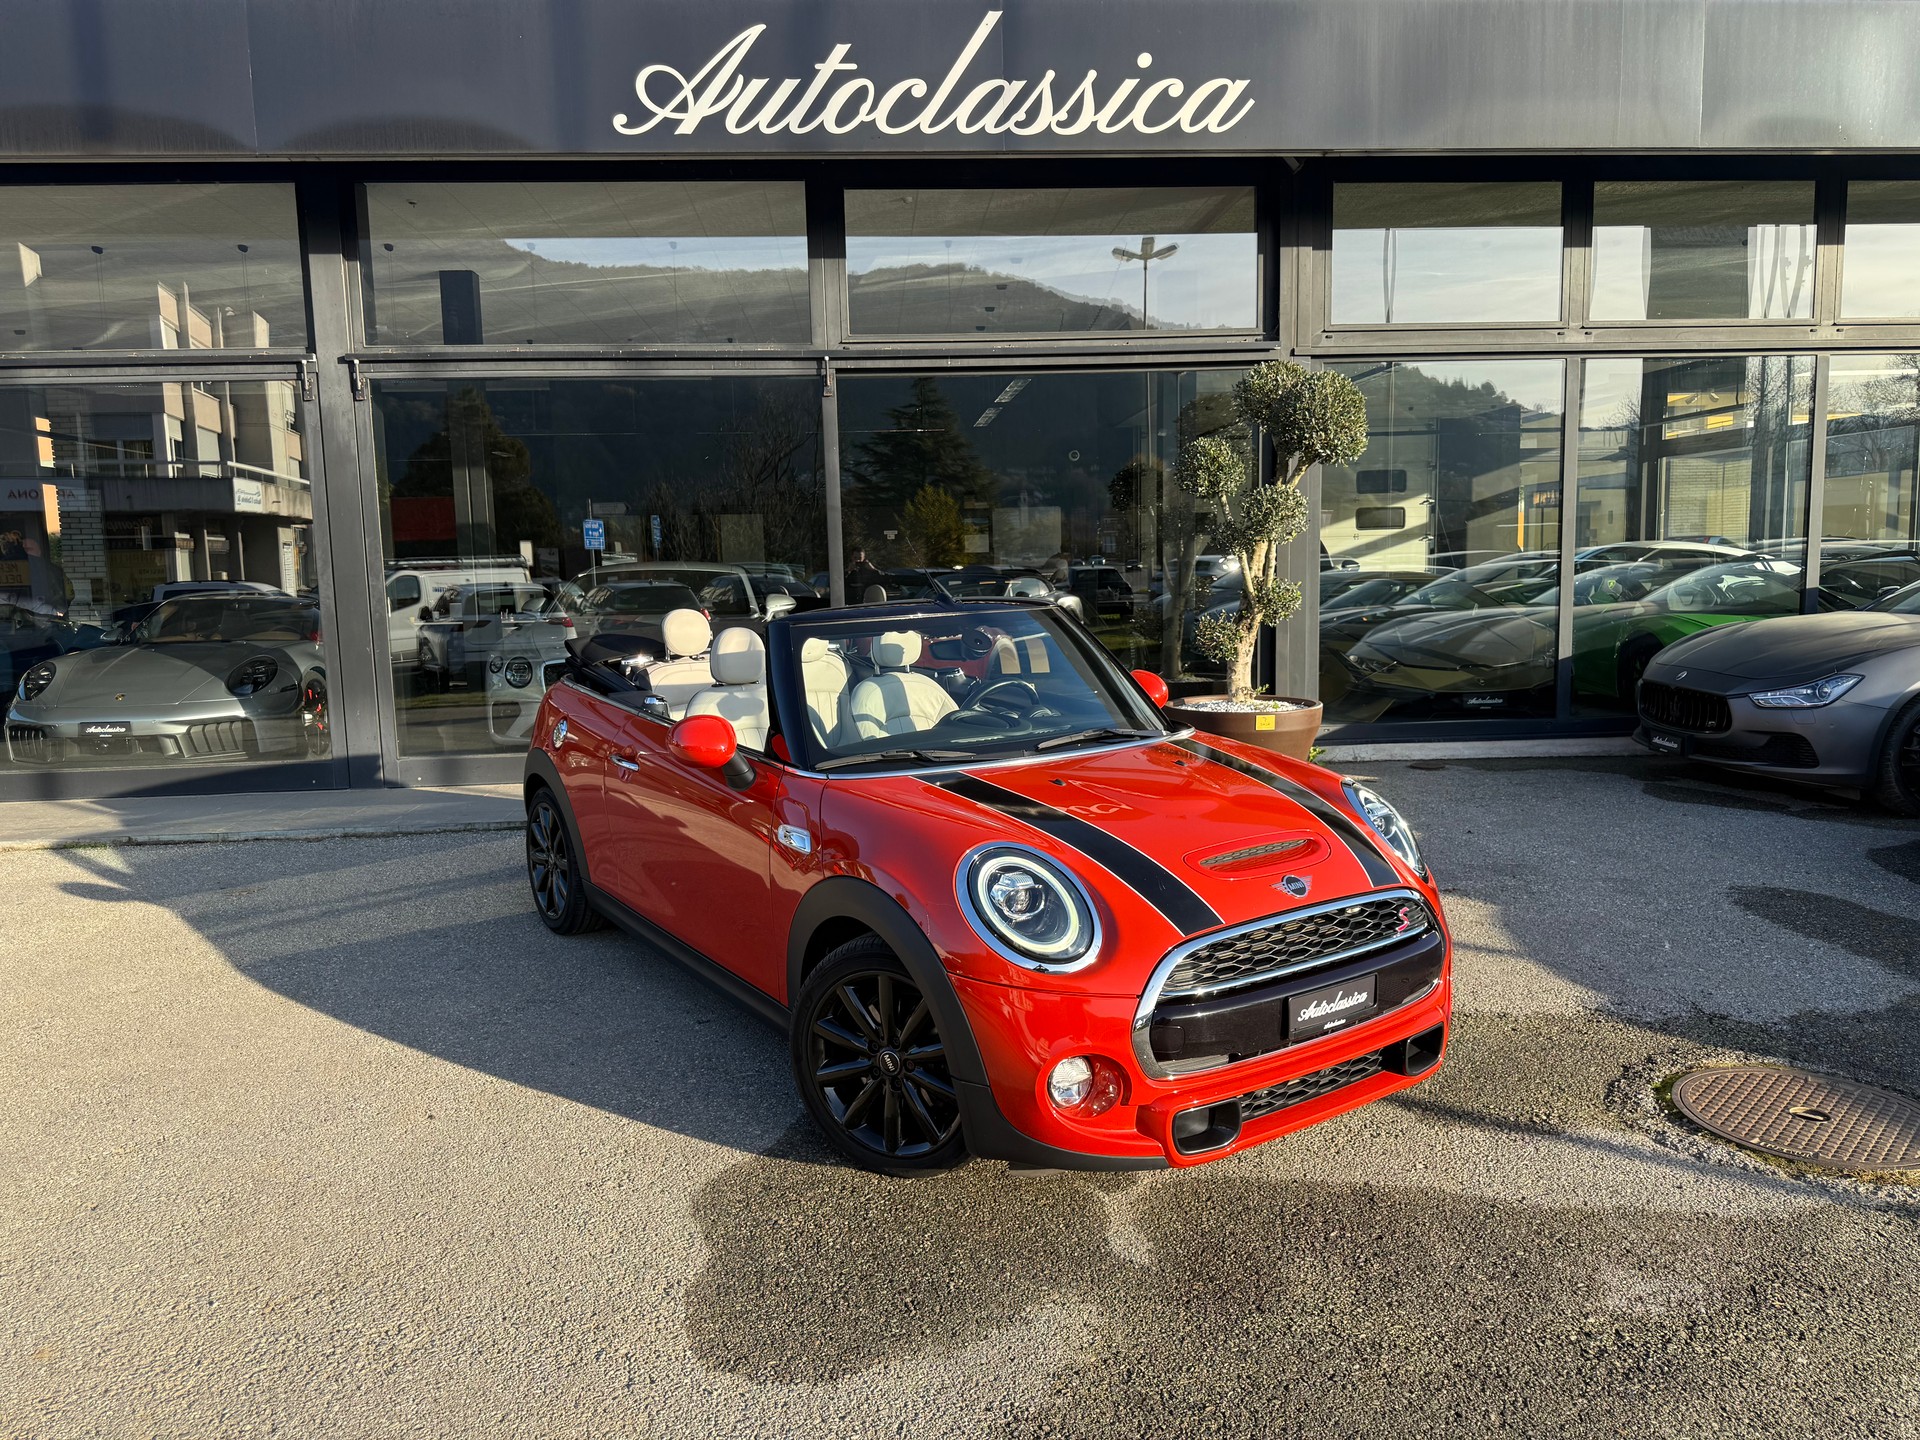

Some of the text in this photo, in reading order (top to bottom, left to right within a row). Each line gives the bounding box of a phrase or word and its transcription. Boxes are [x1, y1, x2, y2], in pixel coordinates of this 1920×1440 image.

[613, 11, 1255, 135] Autoclassica
[1467, 696, 1504, 705] Autoclassica
[85, 724, 126, 733] Autoclassica
[1288, 881, 1305, 891] MINI
[1395, 906, 1410, 932] S
[1297, 990, 1368, 1022] Autoclassica
[883, 1054, 896, 1072] MINI
